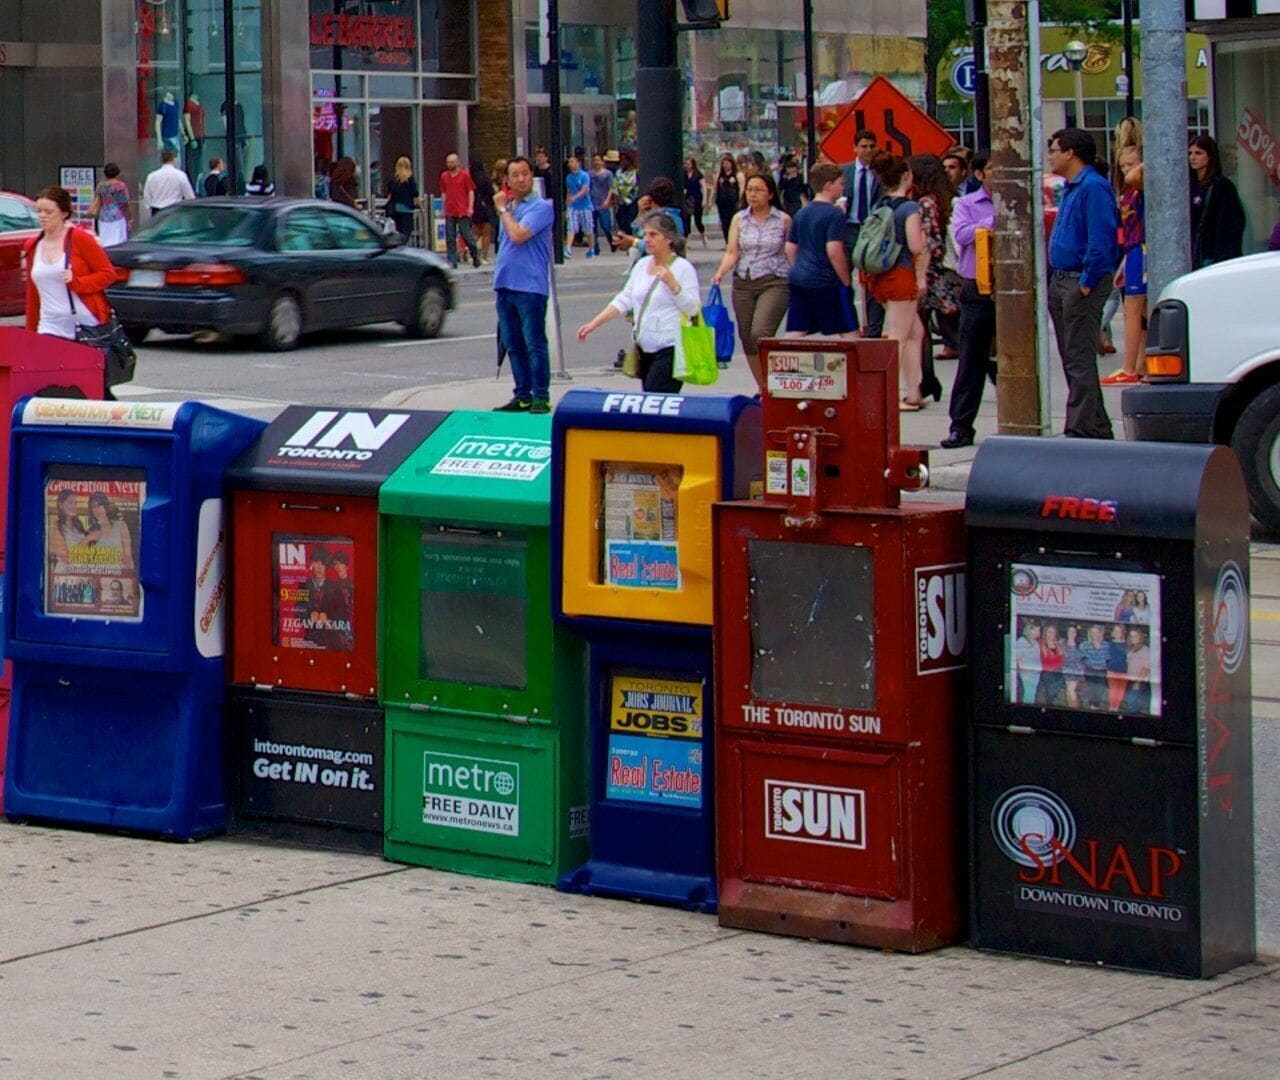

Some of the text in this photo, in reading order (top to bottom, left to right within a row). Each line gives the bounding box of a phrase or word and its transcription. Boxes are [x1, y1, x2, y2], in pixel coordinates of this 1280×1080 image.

[64, 169, 91, 180] FREE
[775, 356, 799, 371] SUN
[602, 393, 685, 417] FREE
[284, 410, 411, 450] IN
[277, 447, 373, 461] TORONTO
[439, 459, 542, 473] FREE DAILY
[48, 480, 140, 495] Generation Next
[1040, 494, 1118, 522] FREE
[279, 543, 307, 565] IN
[1015, 584, 1073, 605] SNAP
[324, 620, 351, 632] SARA
[918, 572, 966, 663] TORONTO SU
[651, 693, 693, 713] JOURNAL
[617, 712, 688, 733] JOBS
[742, 705, 881, 735] THE TORONTO SUN
[254, 738, 373, 766] intorontomag.com
[253, 758, 375, 791] Get IN on it.
[428, 761, 515, 797] metro
[611, 755, 702, 793] Real Estate
[422, 795, 515, 821] FREE DAILY
[772, 786, 856, 841] TORONTO SUN
[422, 811, 514, 833] www.metronews.ca
[1016, 832, 1183, 900] SNAP
[1020, 886, 1182, 922] DOWNTOWN TORONTO
